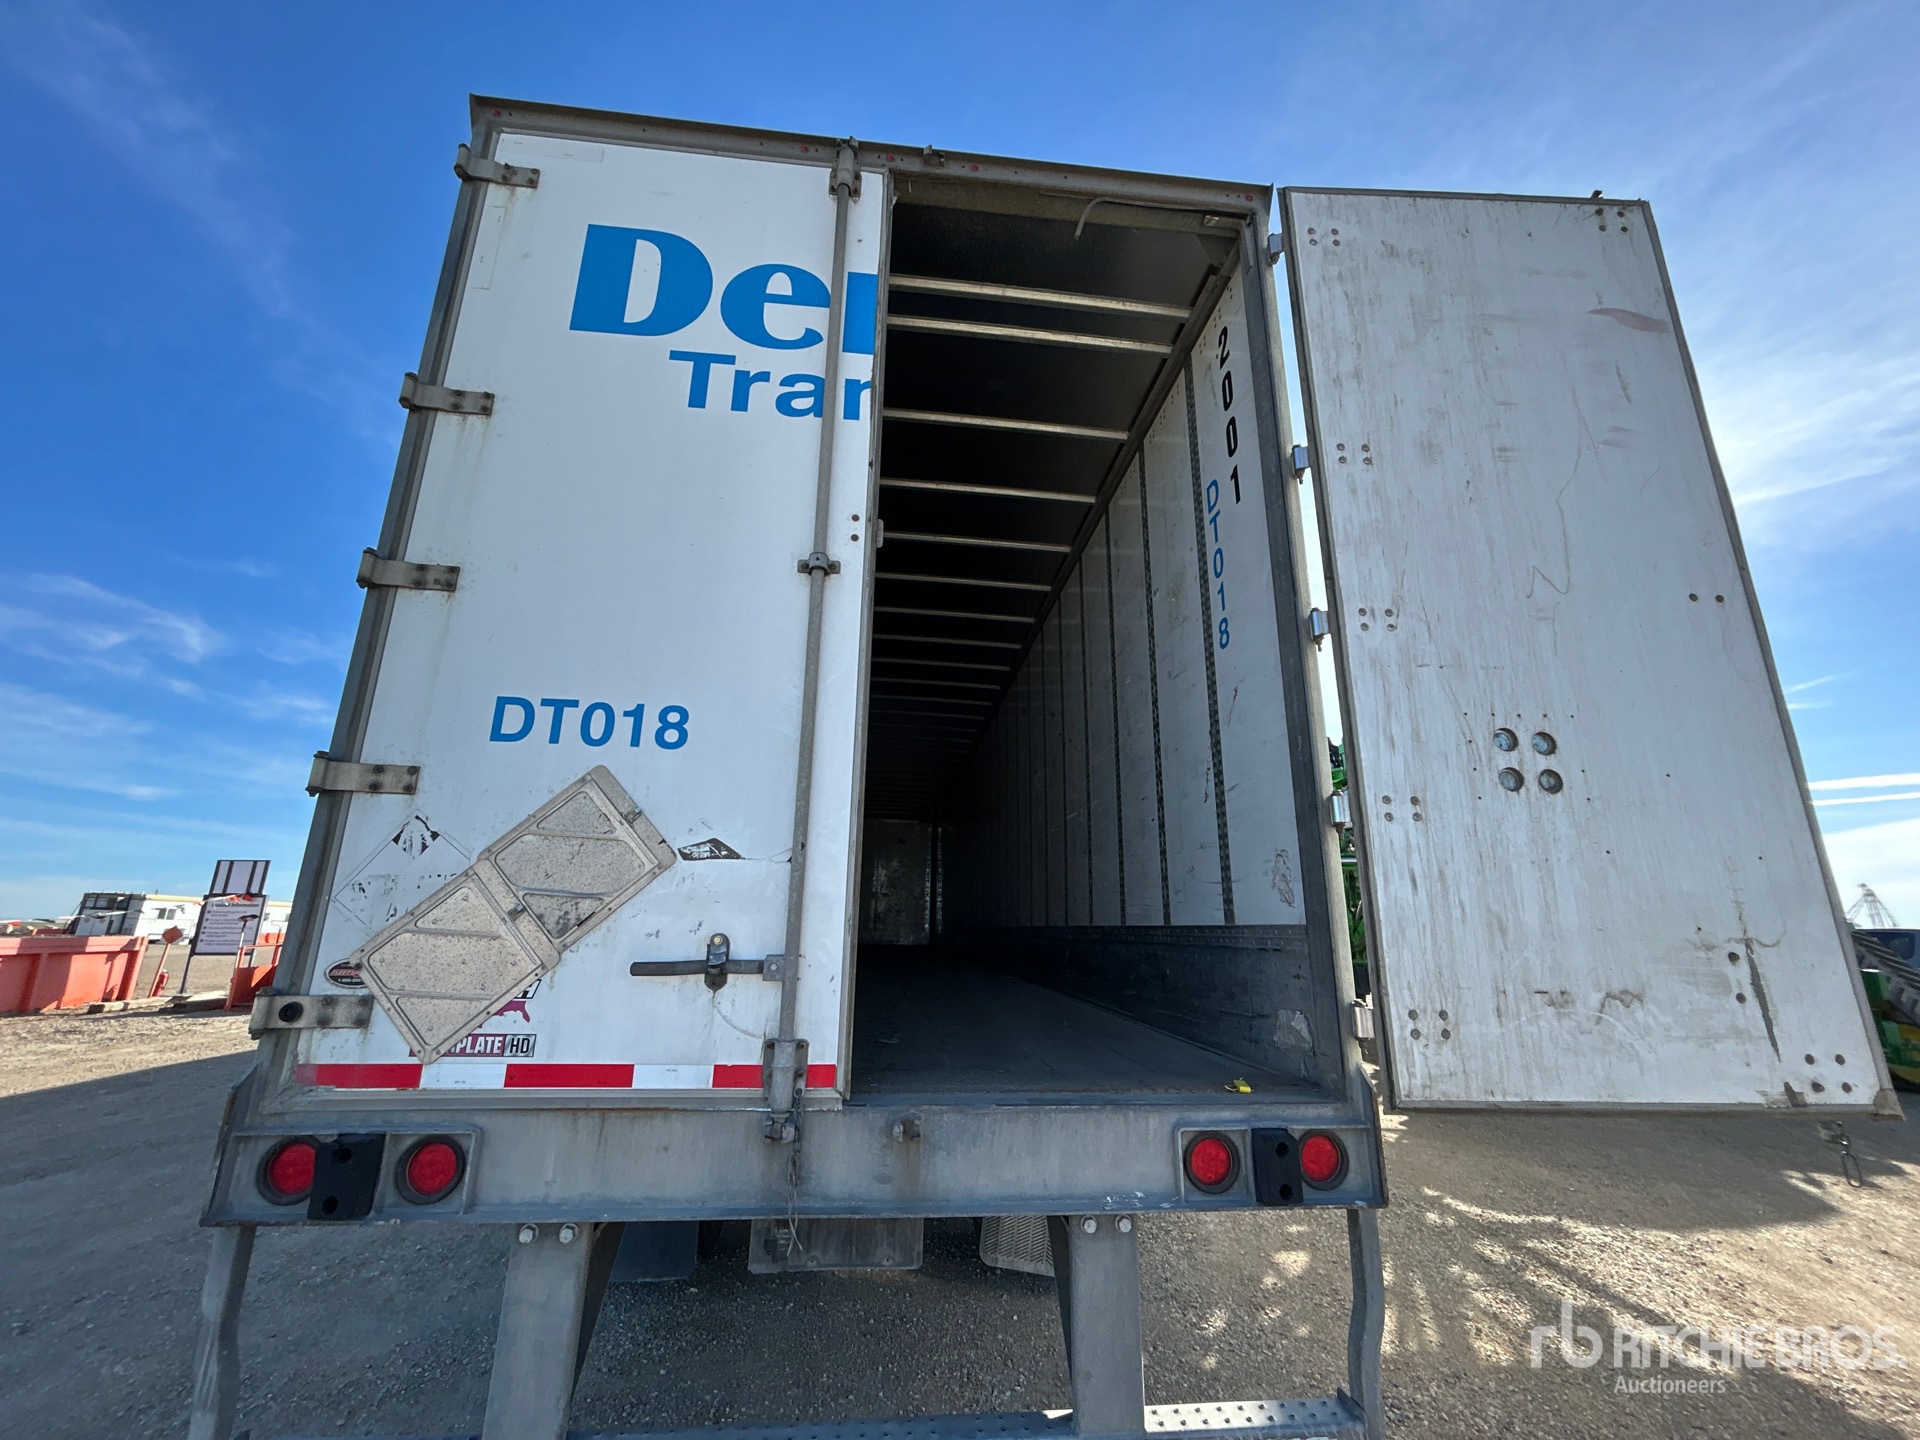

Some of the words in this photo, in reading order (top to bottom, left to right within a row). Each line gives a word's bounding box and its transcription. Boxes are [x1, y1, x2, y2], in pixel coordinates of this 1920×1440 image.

[1217, 325, 1240, 505] 2001
[1206, 479, 1230, 650] DT018
[489, 696, 689, 750] DT018
[445, 1036, 503, 1054] PLATE
[509, 1038, 530, 1054] HD
